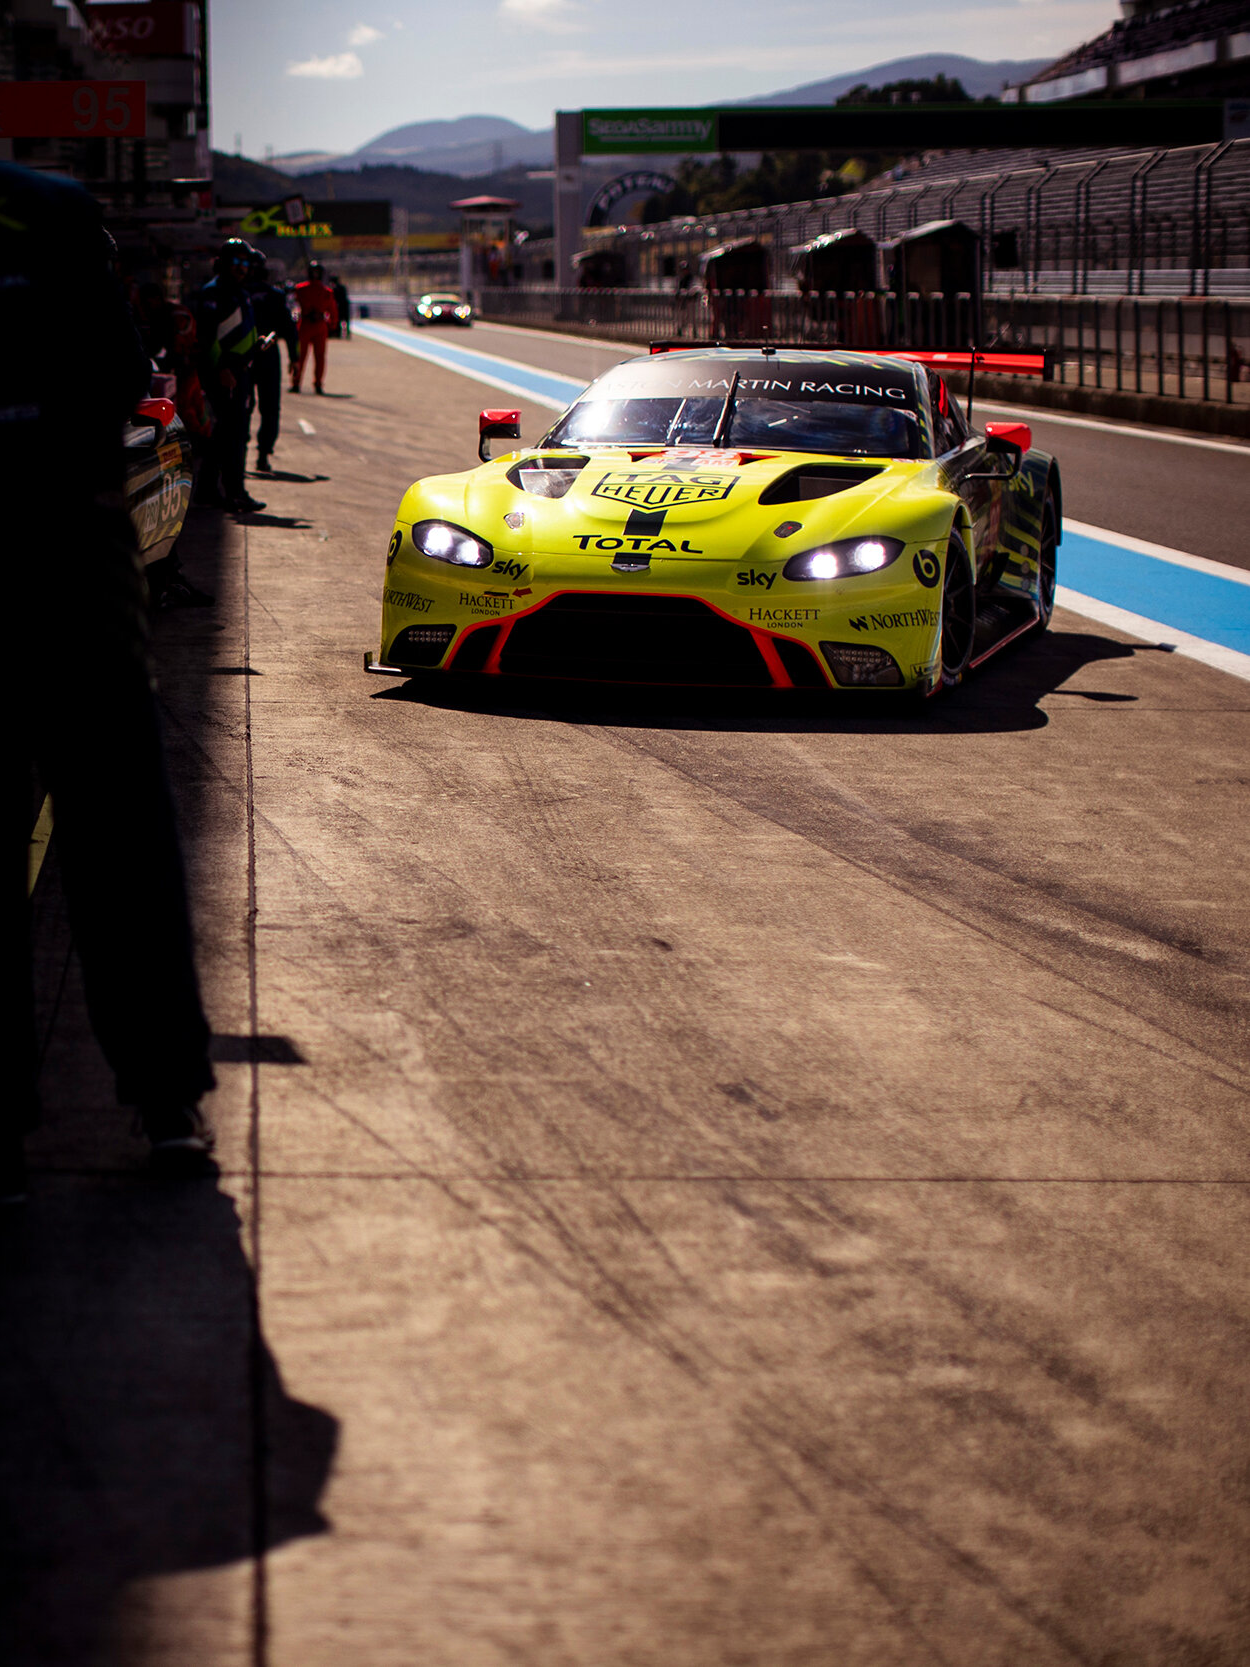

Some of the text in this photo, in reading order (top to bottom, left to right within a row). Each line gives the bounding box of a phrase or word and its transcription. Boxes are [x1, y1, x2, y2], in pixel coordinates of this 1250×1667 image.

[72, 86, 131, 131] 95
[688, 377, 792, 392] MARTIN
[801, 381, 906, 399] RACING
[618, 474, 723, 485] TAG
[162, 470, 181, 522] 95
[602, 486, 720, 505] HEUER
[573, 534, 703, 554] TOTAL
[492, 558, 529, 580] sky
[736, 568, 777, 590] sky
[459, 592, 516, 610] HACKETT
[471, 607, 501, 617] LONDON
[750, 608, 821, 621] HACKETT
